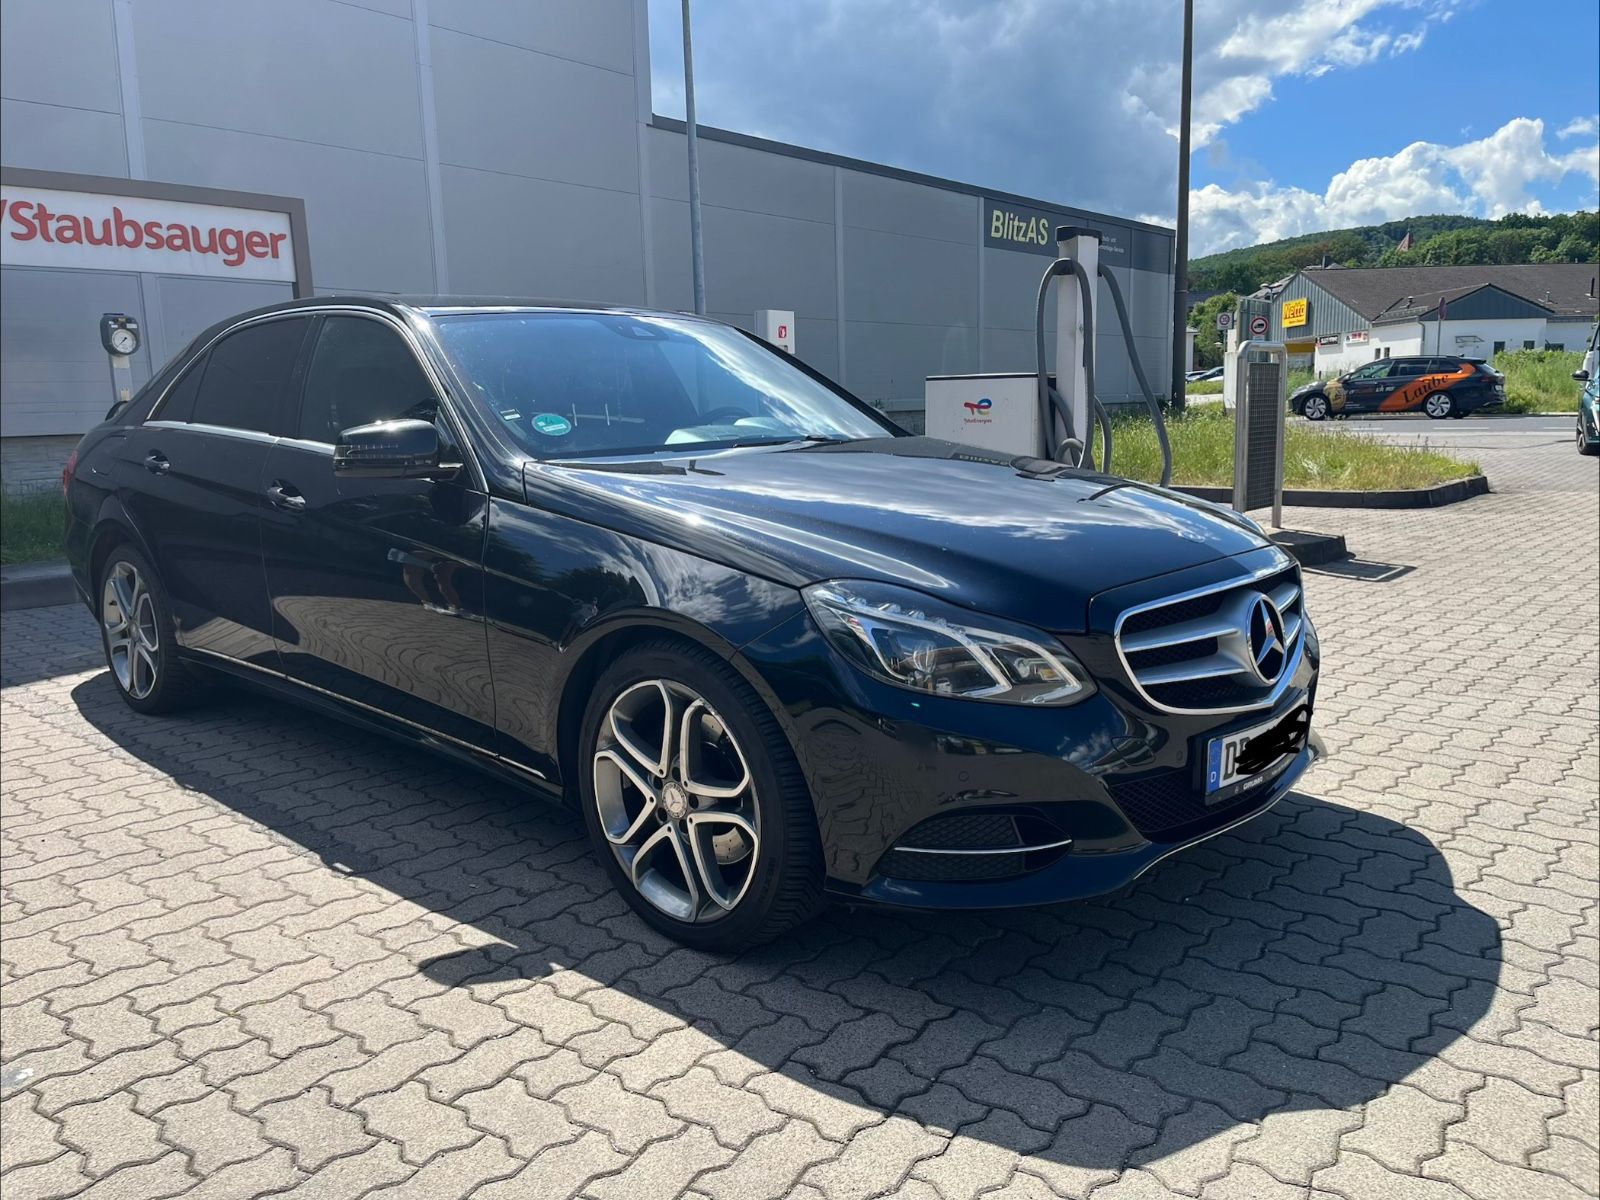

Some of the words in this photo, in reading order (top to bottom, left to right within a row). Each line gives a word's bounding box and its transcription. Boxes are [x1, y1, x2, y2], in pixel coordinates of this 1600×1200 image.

[990, 209, 1049, 246] BlitzAS
[1284, 303, 1305, 320] Netto
[1403, 375, 1448, 403] Laube
